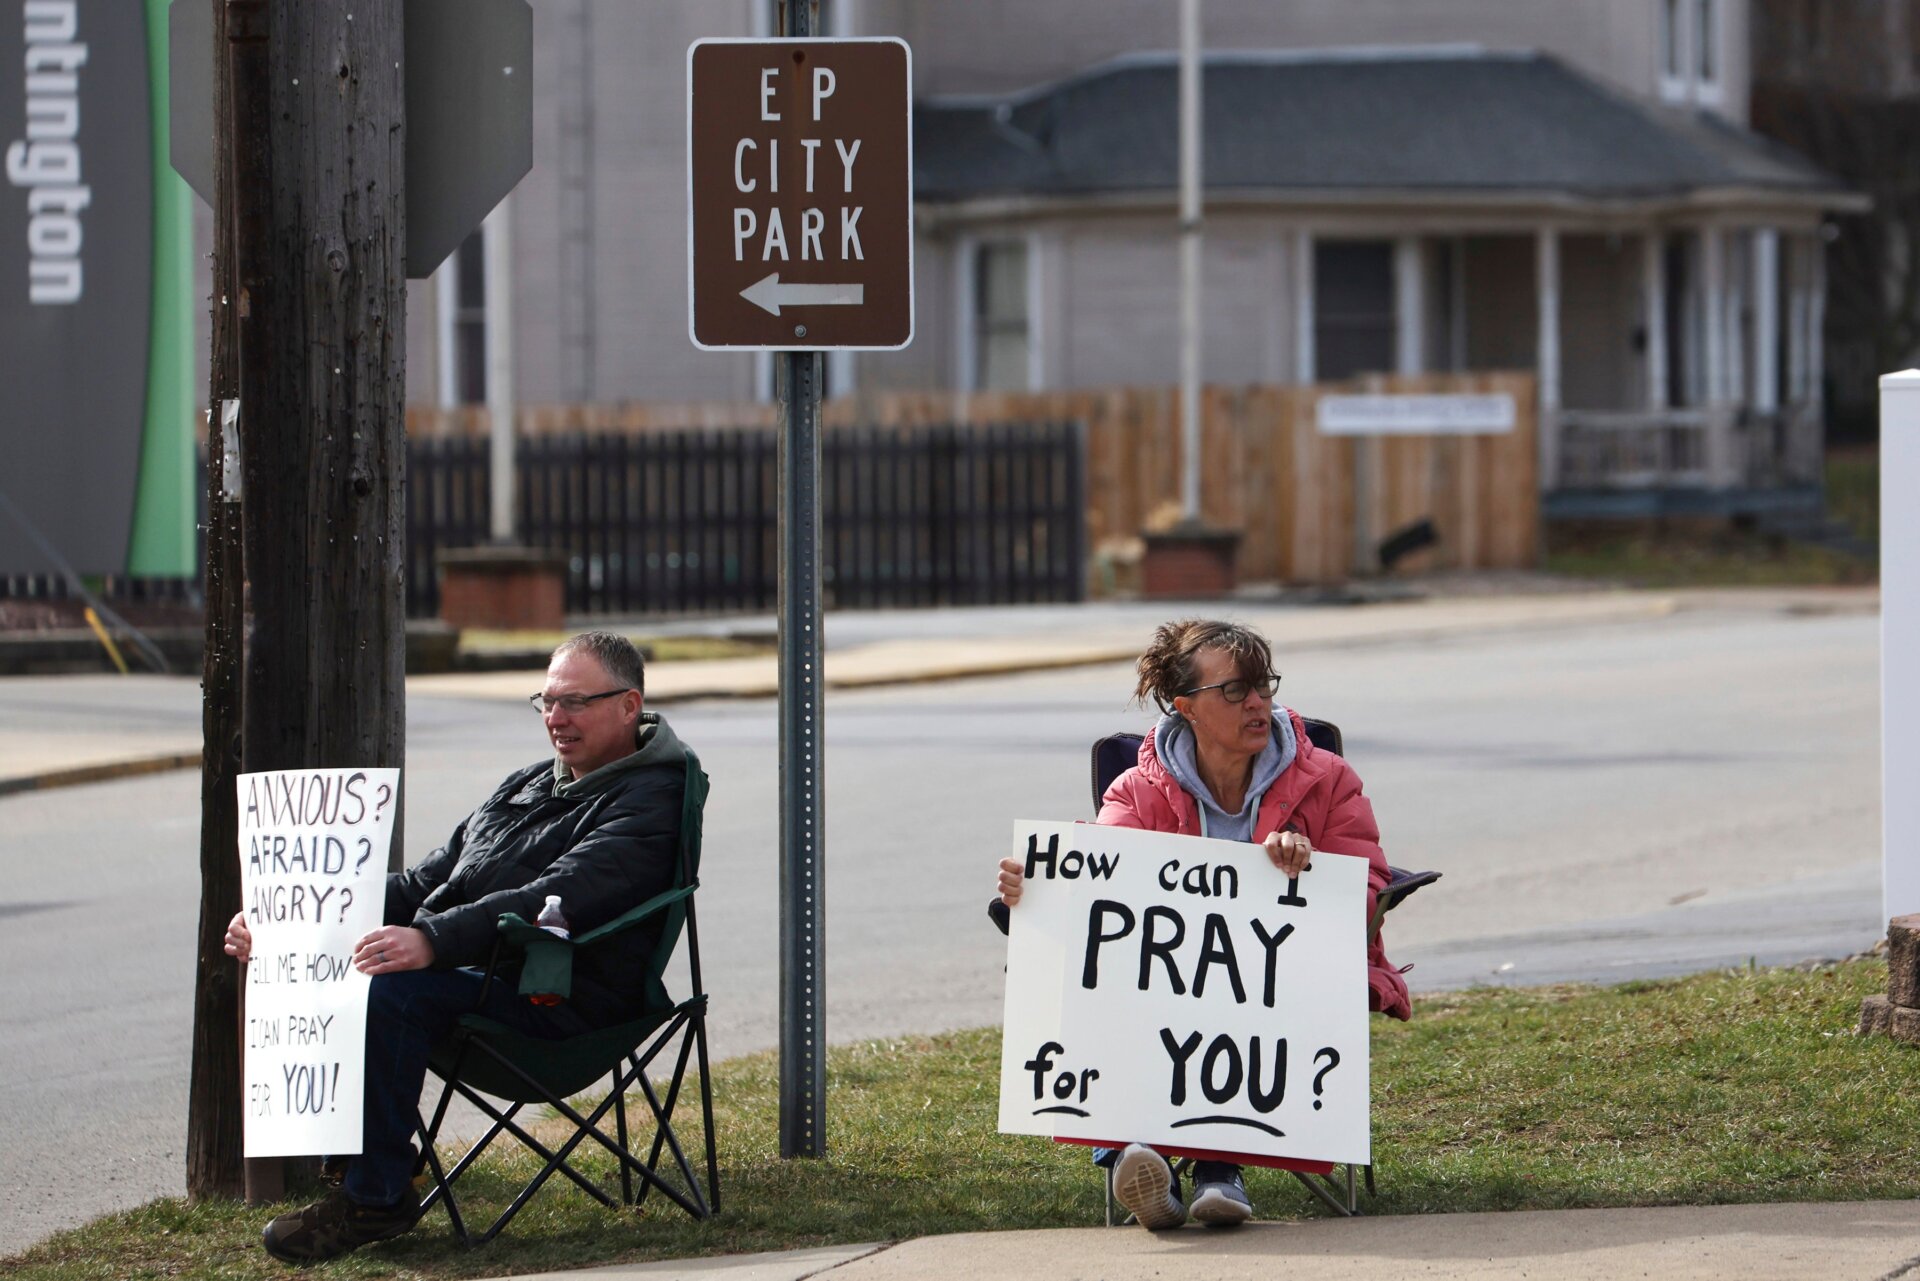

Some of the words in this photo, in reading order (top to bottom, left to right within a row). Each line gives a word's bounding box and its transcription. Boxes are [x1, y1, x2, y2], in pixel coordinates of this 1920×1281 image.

[761, 67, 781, 121] E
[812, 67, 836, 121] P
[734, 137, 862, 193] CITY
[733, 206, 864, 261] PARK
[246, 772, 392, 828] ANXIOUS?
[249, 834, 372, 877] AFRAID?
[1024, 833, 1120, 880] How
[1158, 859, 1238, 899] can
[249, 885, 353, 924] ANGRY?
[277, 953, 297, 984] ME
[306, 953, 353, 982] HOW
[1082, 899, 1295, 1008] PRAY
[259, 1018, 280, 1048] CAN
[288, 1014, 334, 1045] PRAY
[251, 1083, 271, 1117] FOR
[283, 1062, 340, 1115] YOU!
[1024, 1041, 1099, 1103] for
